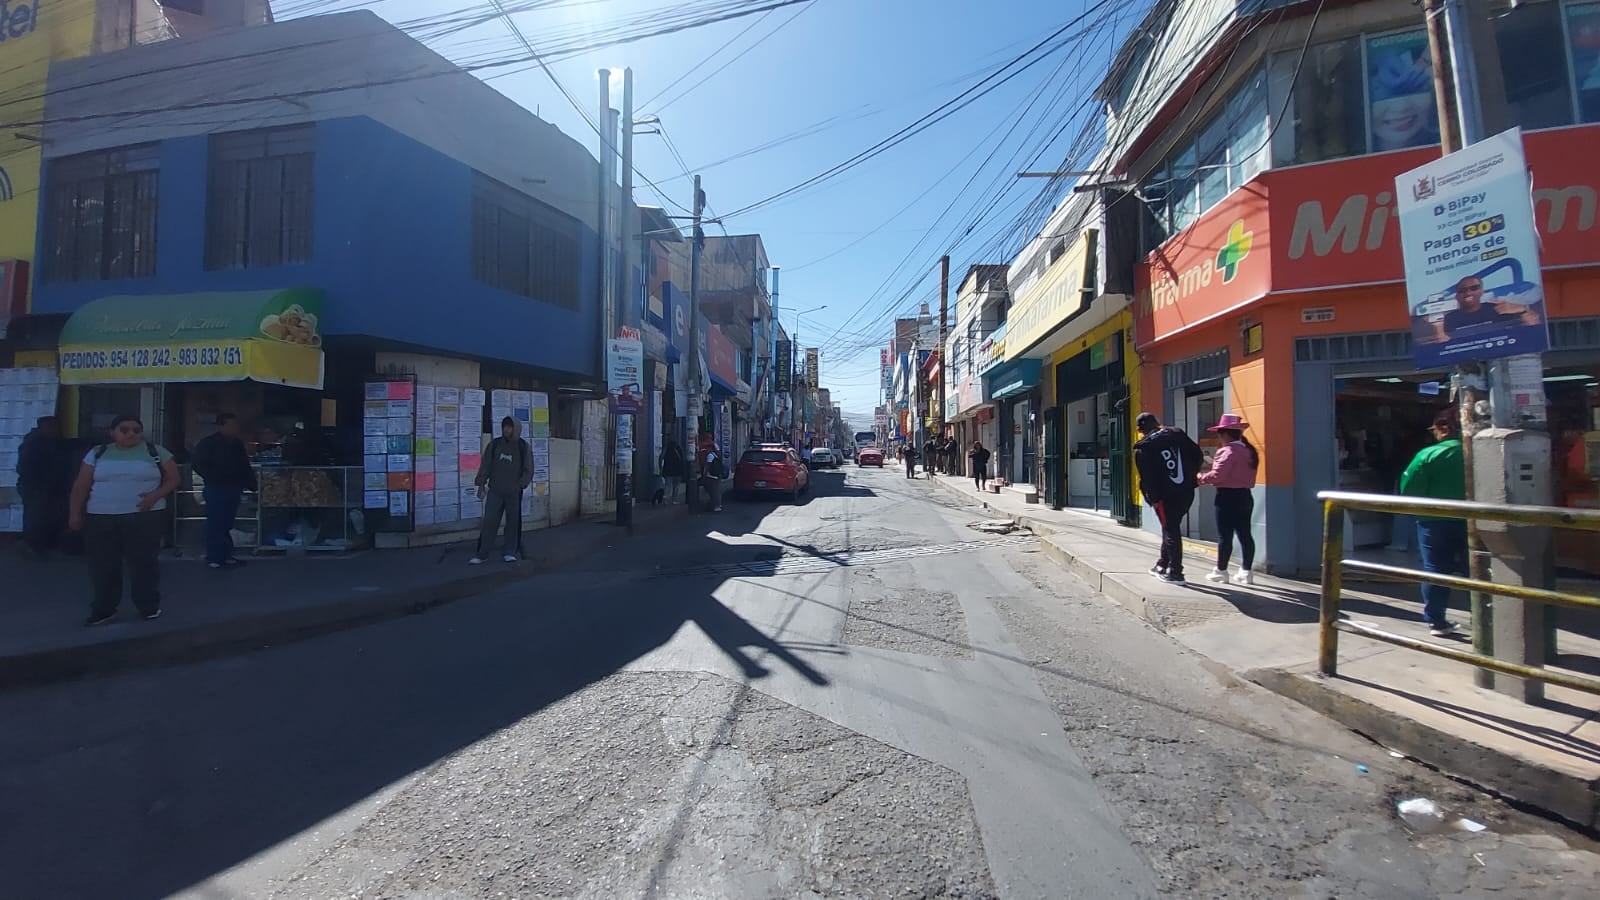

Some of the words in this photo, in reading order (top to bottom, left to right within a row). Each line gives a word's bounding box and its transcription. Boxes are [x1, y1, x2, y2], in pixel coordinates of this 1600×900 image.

[1462, 157, 1504, 177] COLORADO
[1448, 191, 1486, 212] BiPay
[1424, 233, 1461, 252] Paga
[1464, 217, 1503, 239] 30%
[1427, 241, 1481, 265] menos
[1484, 235, 1505, 249] de
[1138, 258, 1213, 318] Mifarma
[62, 351, 108, 370] PEDIDOS:
[110, 349, 129, 368] 954
[131, 348, 149, 367] 128
[151, 348, 170, 367] 242
[178, 347, 198, 366] 983
[200, 346, 220, 366] 832
[223, 346, 242, 366] 151
